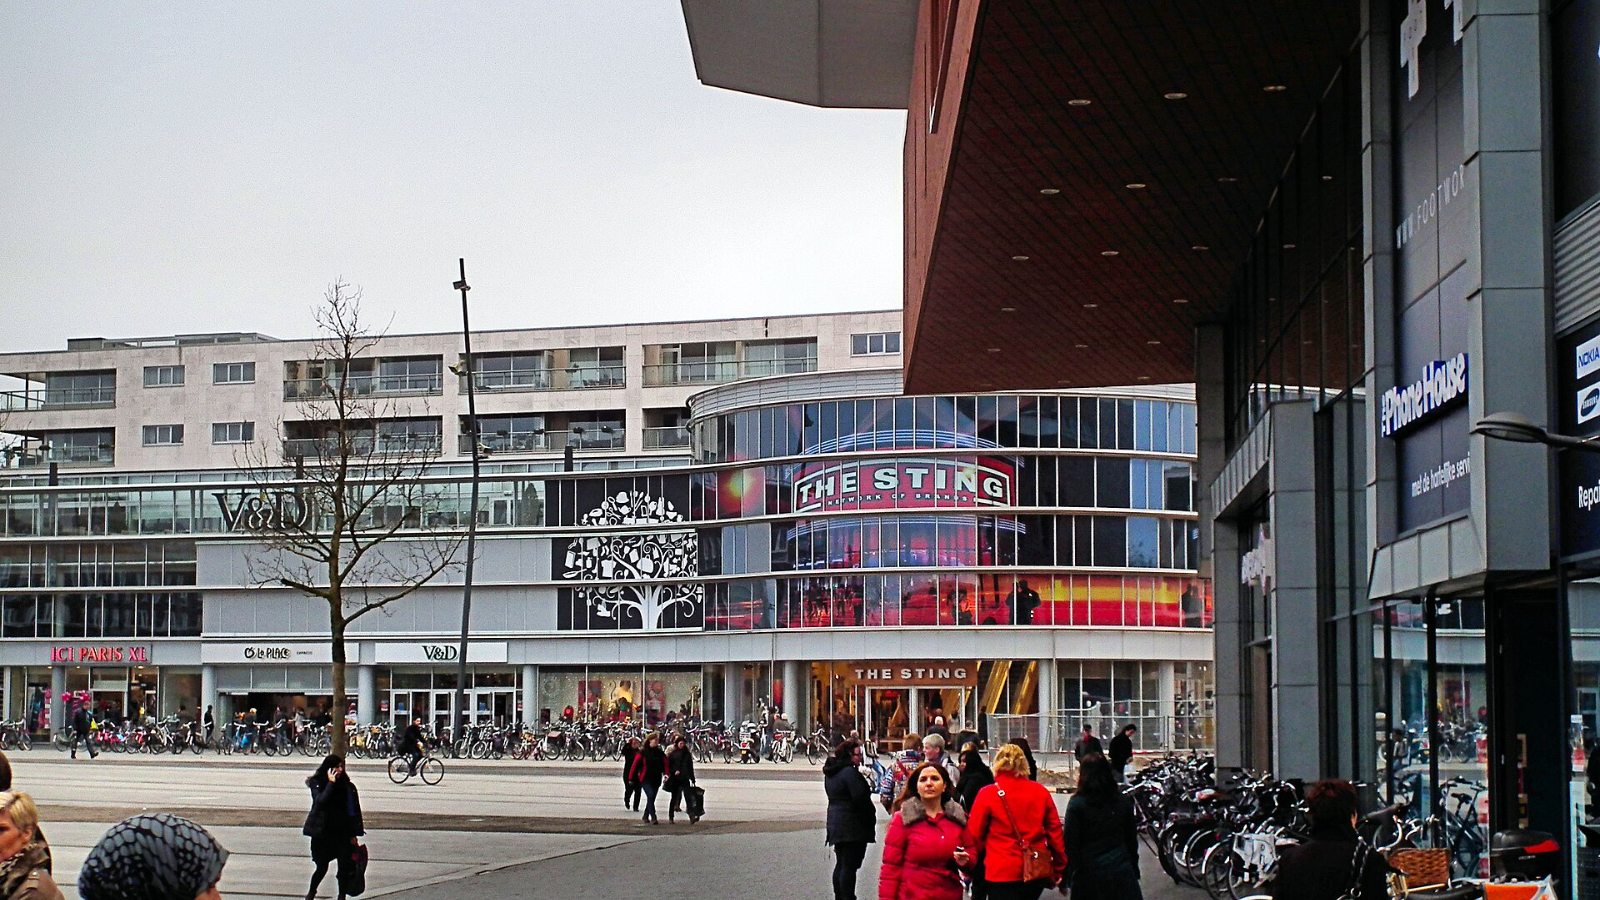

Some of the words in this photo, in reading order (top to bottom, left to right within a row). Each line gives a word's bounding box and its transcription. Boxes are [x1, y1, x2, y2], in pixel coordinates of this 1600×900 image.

[1578, 346, 1600, 368] NOKIA
[799, 471, 857, 504] THE
[874, 467, 1004, 498] STING
[1422, 472, 1430, 493] de
[827, 494, 882, 506] NETWORK
[891, 493, 906, 501] OF
[211, 491, 308, 532] V&D
[50, 646, 75, 662] ICI
[78, 646, 123, 662] PARIS
[128, 646, 148, 662] XL
[421, 645, 458, 661] V&D
[855, 668, 892, 680] THE
[900, 668, 967, 680] STING
